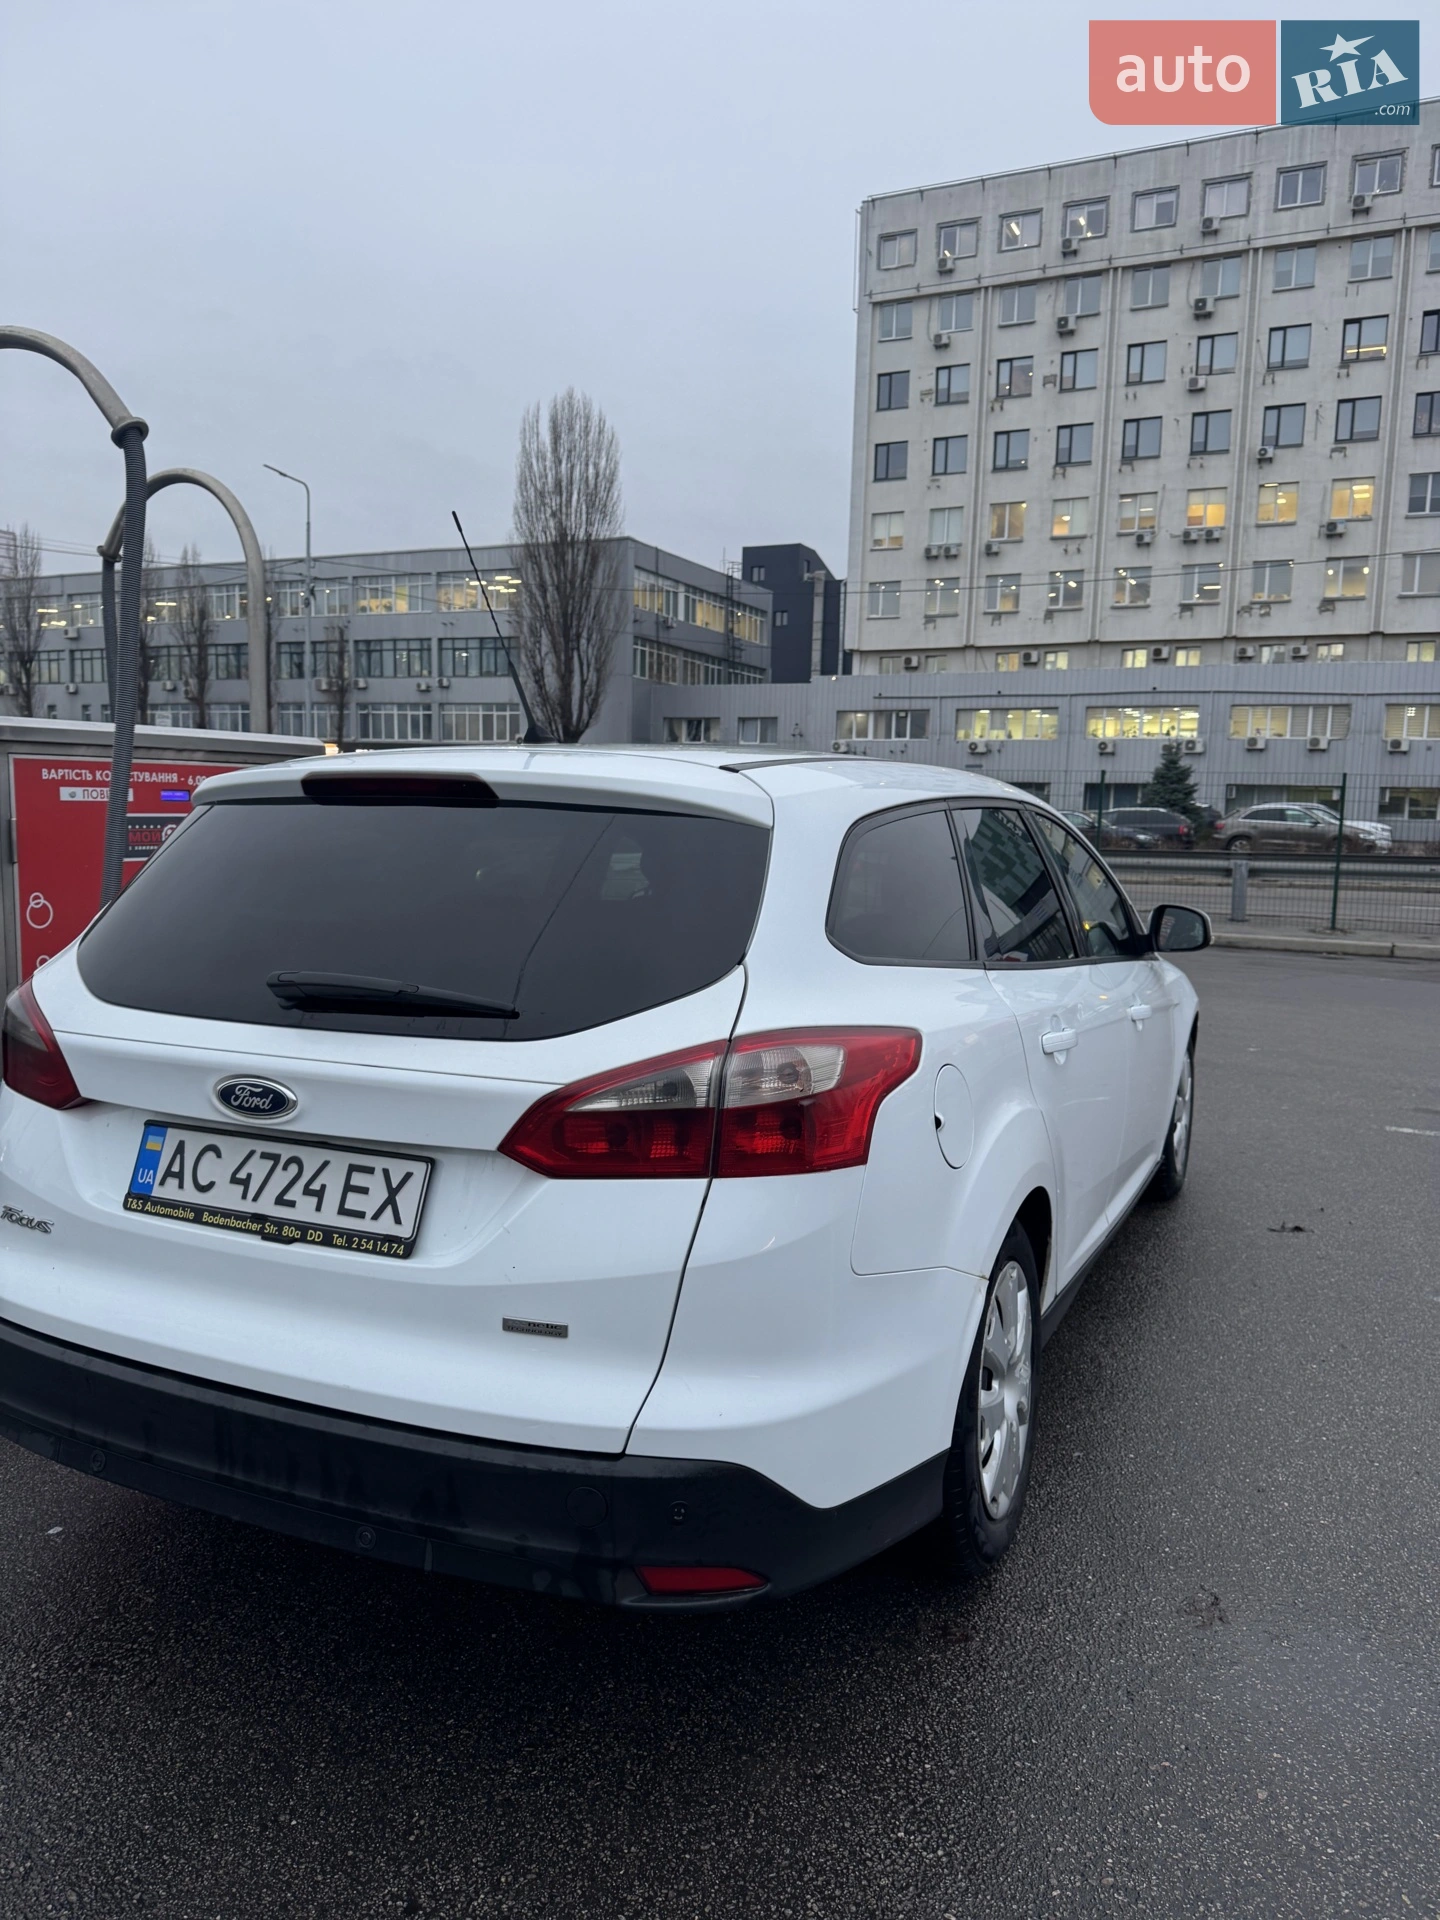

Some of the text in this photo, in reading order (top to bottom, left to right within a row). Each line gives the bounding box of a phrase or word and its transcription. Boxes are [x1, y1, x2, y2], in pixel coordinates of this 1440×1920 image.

[41, 768, 93, 781] ВАРТІСТЬ
[95, 770, 178, 783] КОТУВАННЯ
[230, 1084, 274, 1110] Ford
[137, 1168, 155, 1185] UA
[158, 1139, 414, 1225] AC 4724 EX
[126, 1198, 143, 1211] T&S
[144, 1201, 195, 1220] Automobile
[202, 1211, 263, 1232] Bodenbacher
[263, 1222, 279, 1235] Str.
[281, 1225, 302, 1239] 80a
[306, 1229, 323, 1242] DD
[332, 1233, 349, 1247] Tel.
